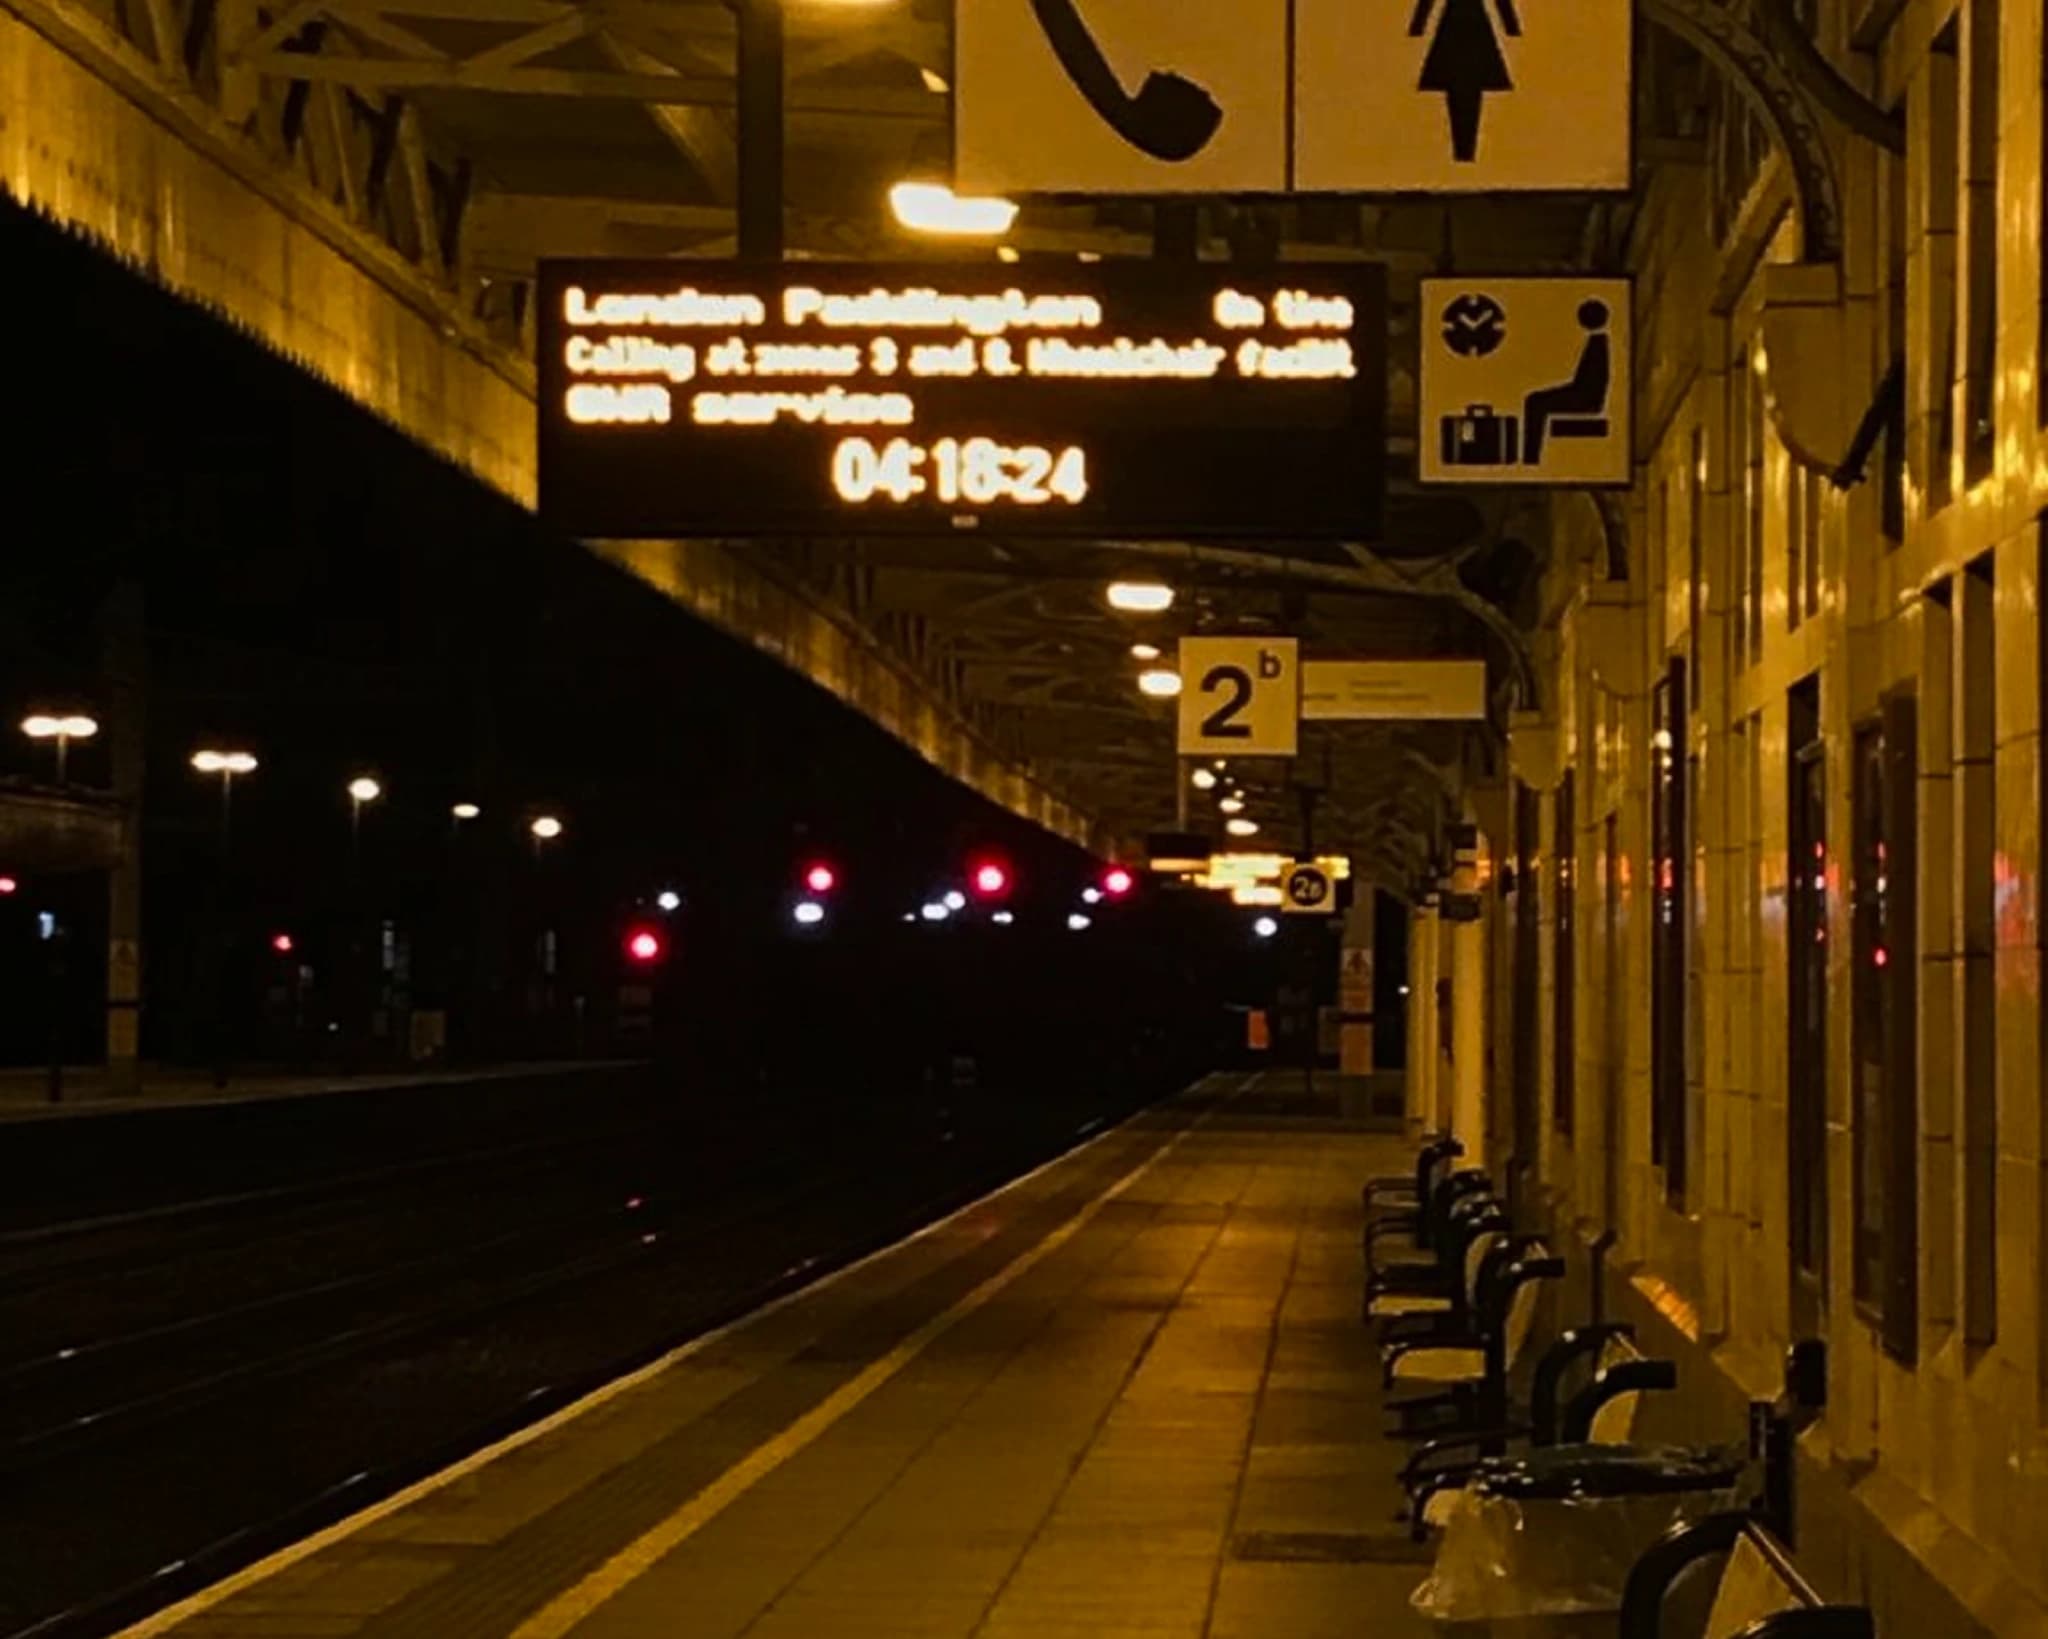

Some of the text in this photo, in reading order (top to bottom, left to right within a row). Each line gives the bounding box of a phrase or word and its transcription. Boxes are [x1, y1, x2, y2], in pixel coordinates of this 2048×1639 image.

[565, 287, 1354, 334] London Paddington On time
[566, 337, 696, 384] Calling
[908, 338, 977, 375] and
[1028, 338, 1226, 377] Wheelchair
[693, 386, 914, 424] service
[833, 437, 1087, 503] 04:18:24
